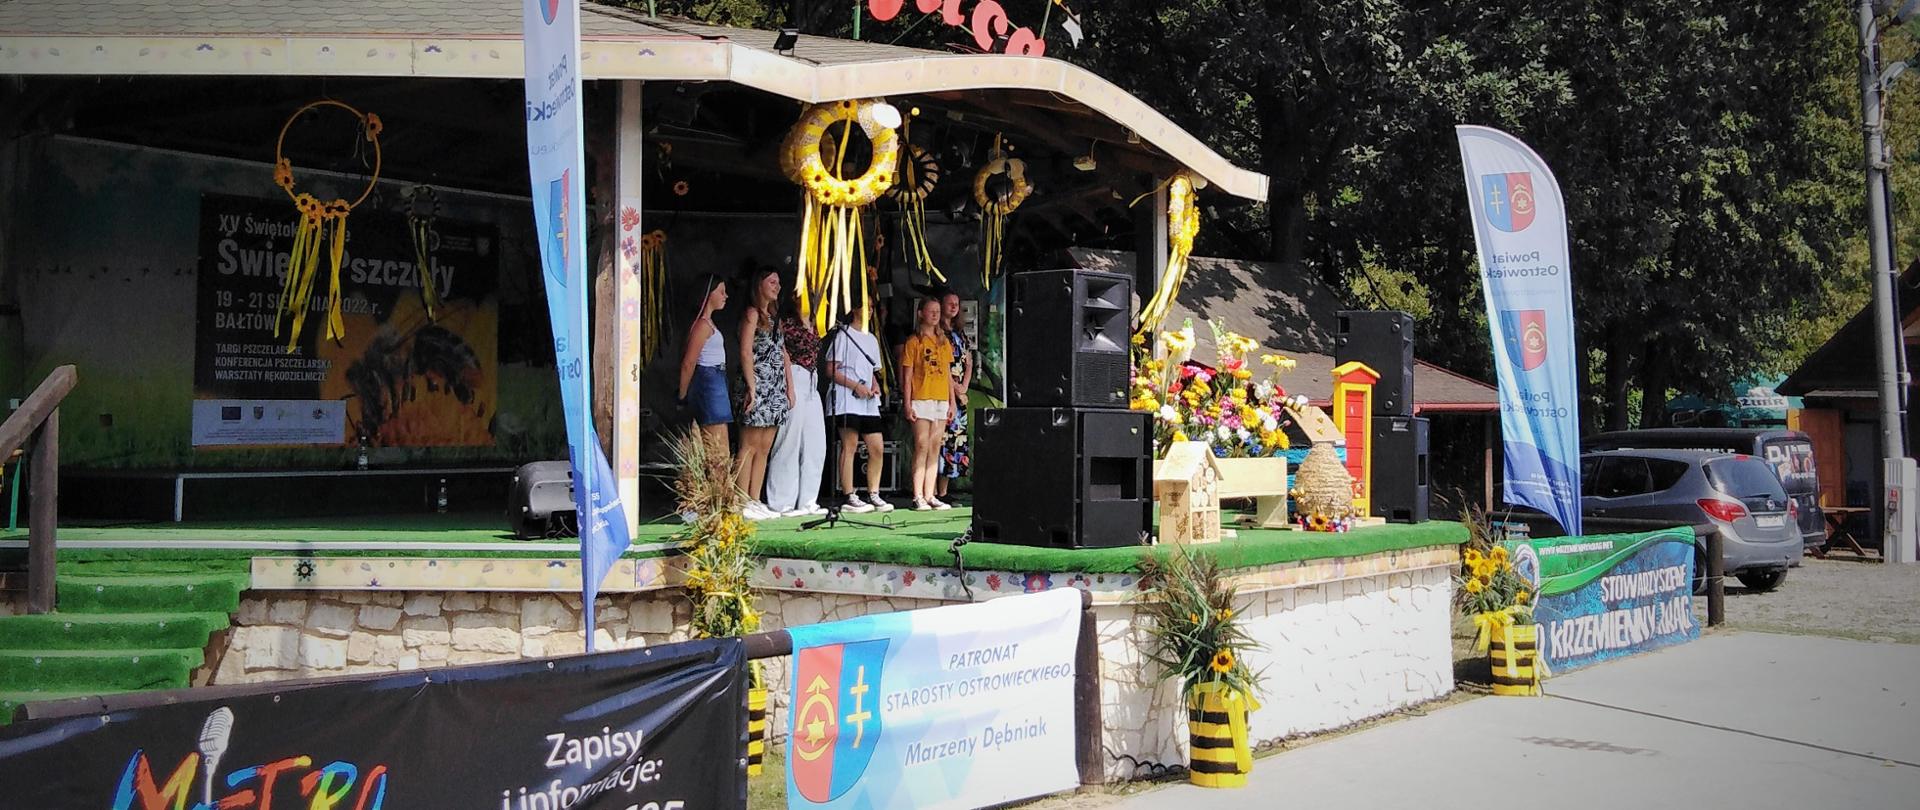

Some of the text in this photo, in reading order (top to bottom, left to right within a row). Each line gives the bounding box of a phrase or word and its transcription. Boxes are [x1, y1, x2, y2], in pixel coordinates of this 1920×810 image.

[218, 214, 241, 233] XV
[217, 232, 319, 287] Świę
[216, 290, 232, 308] 19
[248, 292, 263, 309] 21
[339, 296, 368, 314] 022
[215, 310, 276, 331] BAŁTÓW
[216, 343, 302, 356] TARGI PSZCZELARSIE
[214, 356, 333, 369] KONFERENCJA PSZCZELARSKA
[214, 369, 263, 381] WARSZTATY
[949, 643, 1019, 670] PATRONAT
[886, 662, 1071, 712] STAROSTY OSTROWIECKIEGO
[545, 726, 643, 770] Zapisy
[904, 715, 1047, 767] Marzeny Dębniak
[518, 756, 664, 810] informacje:
